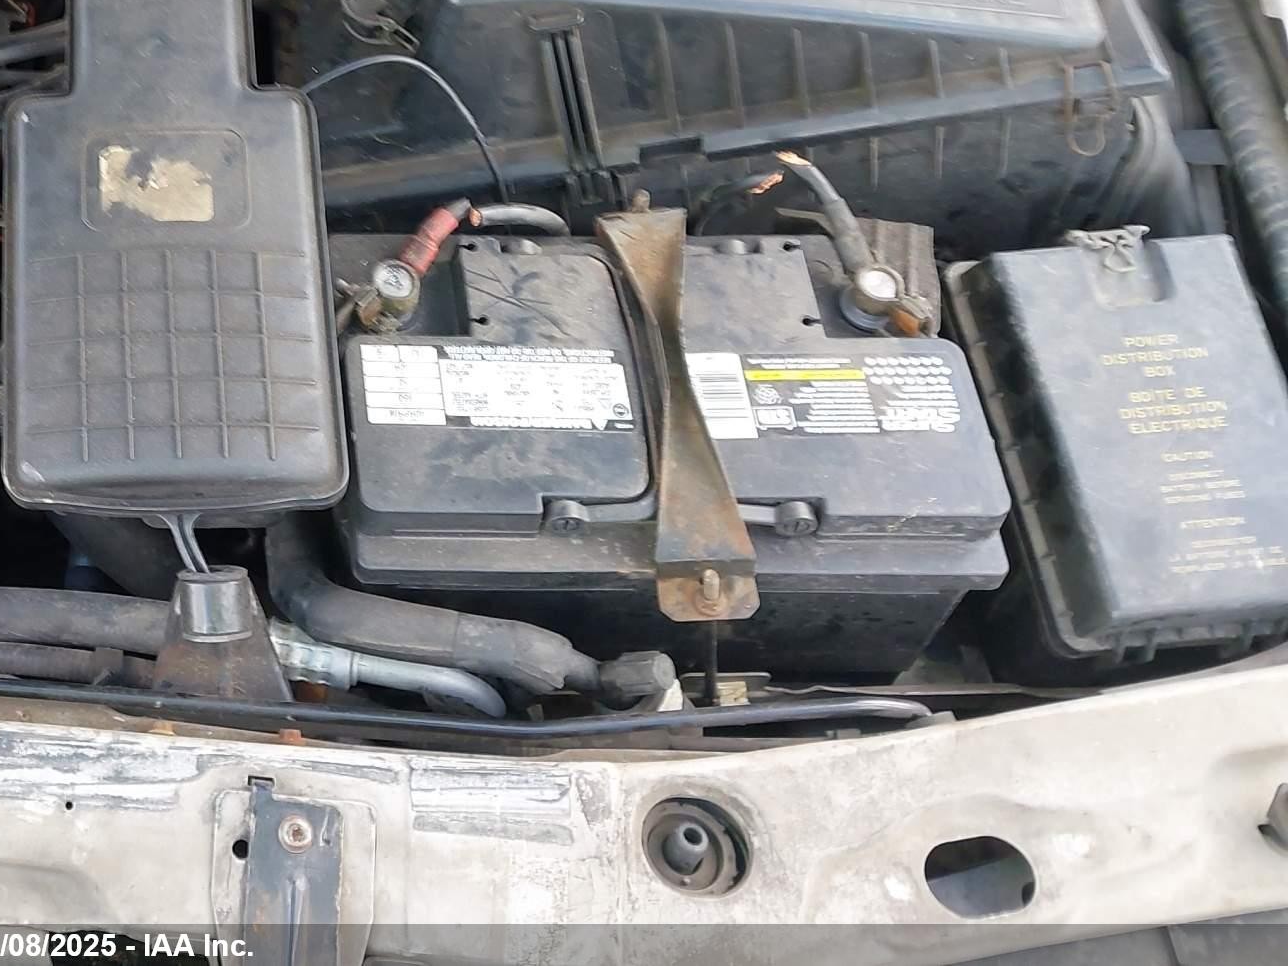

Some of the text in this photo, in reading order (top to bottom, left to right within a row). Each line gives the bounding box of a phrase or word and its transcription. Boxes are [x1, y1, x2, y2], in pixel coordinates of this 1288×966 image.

[1123, 334, 1179, 347] POWER
[1102, 347, 1210, 366] DISTRIBUTION
[1143, 365, 1176, 378] BOX
[1184, 386, 1208, 399] DE
[1119, 400, 1229, 420] DISTRIBUTION
